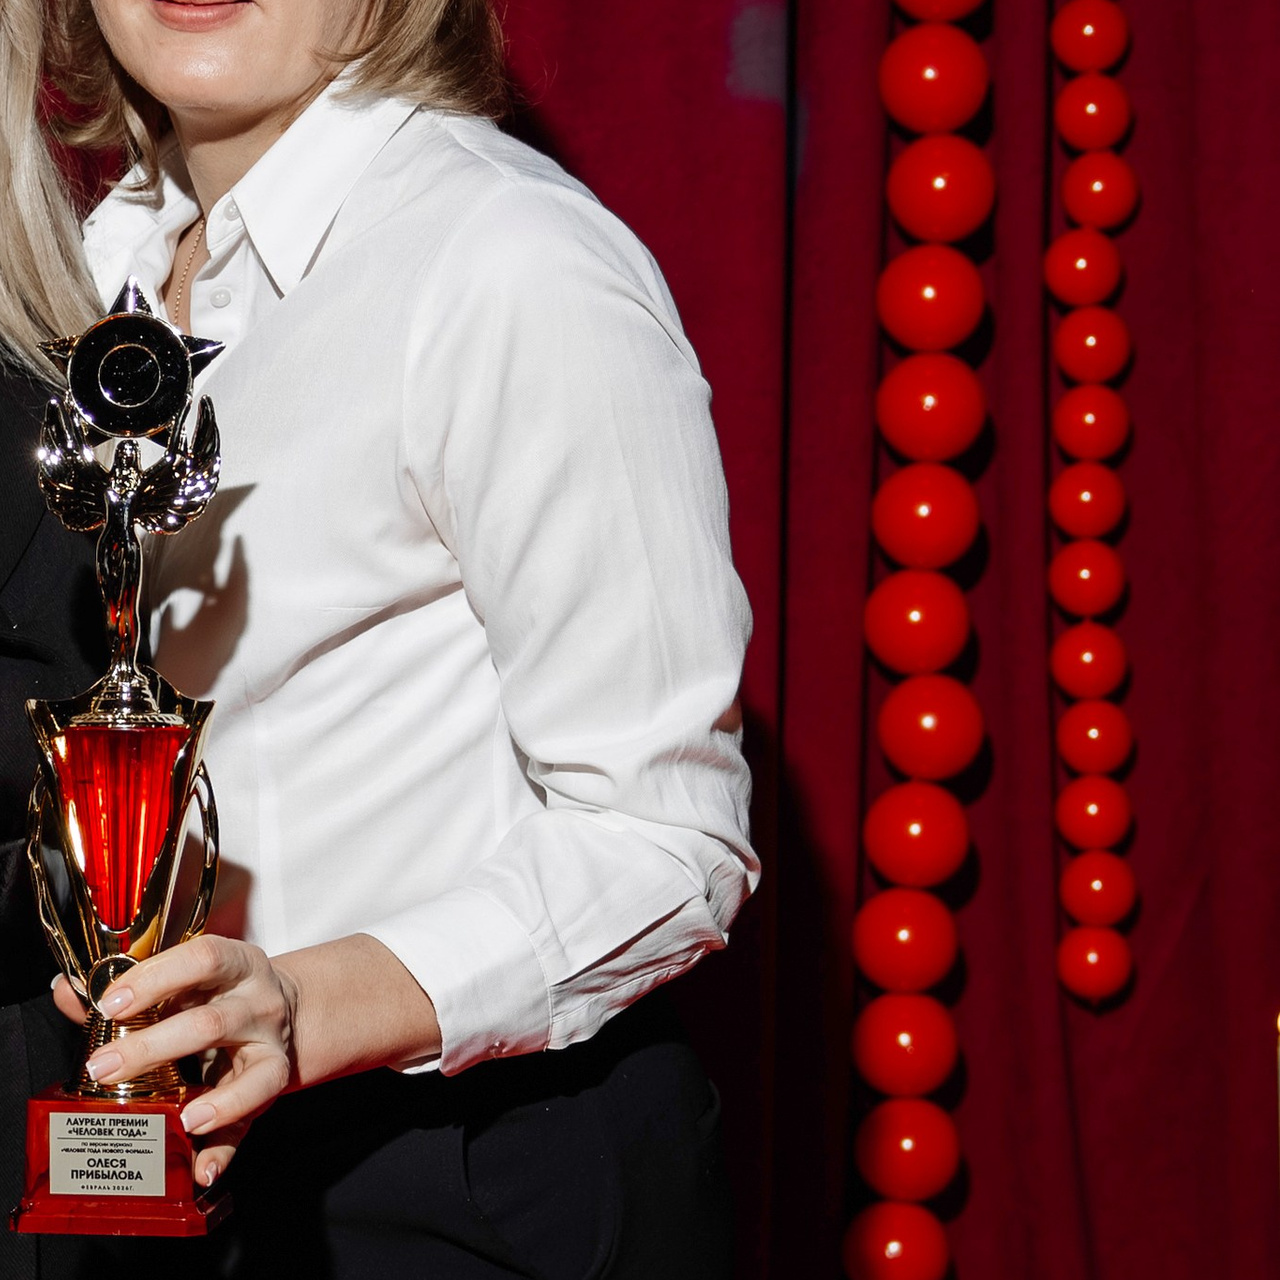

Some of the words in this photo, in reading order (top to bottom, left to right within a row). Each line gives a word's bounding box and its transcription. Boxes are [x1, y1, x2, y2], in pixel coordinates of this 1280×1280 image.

[66, 1117, 106, 1126] ЛАУРЕАТ
[109, 1118, 149, 1127] ПРЕМИИ
[68, 1127, 114, 1136] «ЧЕЛОВЕК
[117, 1128, 147, 1138] ГОДА»
[87, 1158, 127, 1168] ОЛЕСЯ
[71, 1169, 144, 1181] ПРИБЫЛОВА
